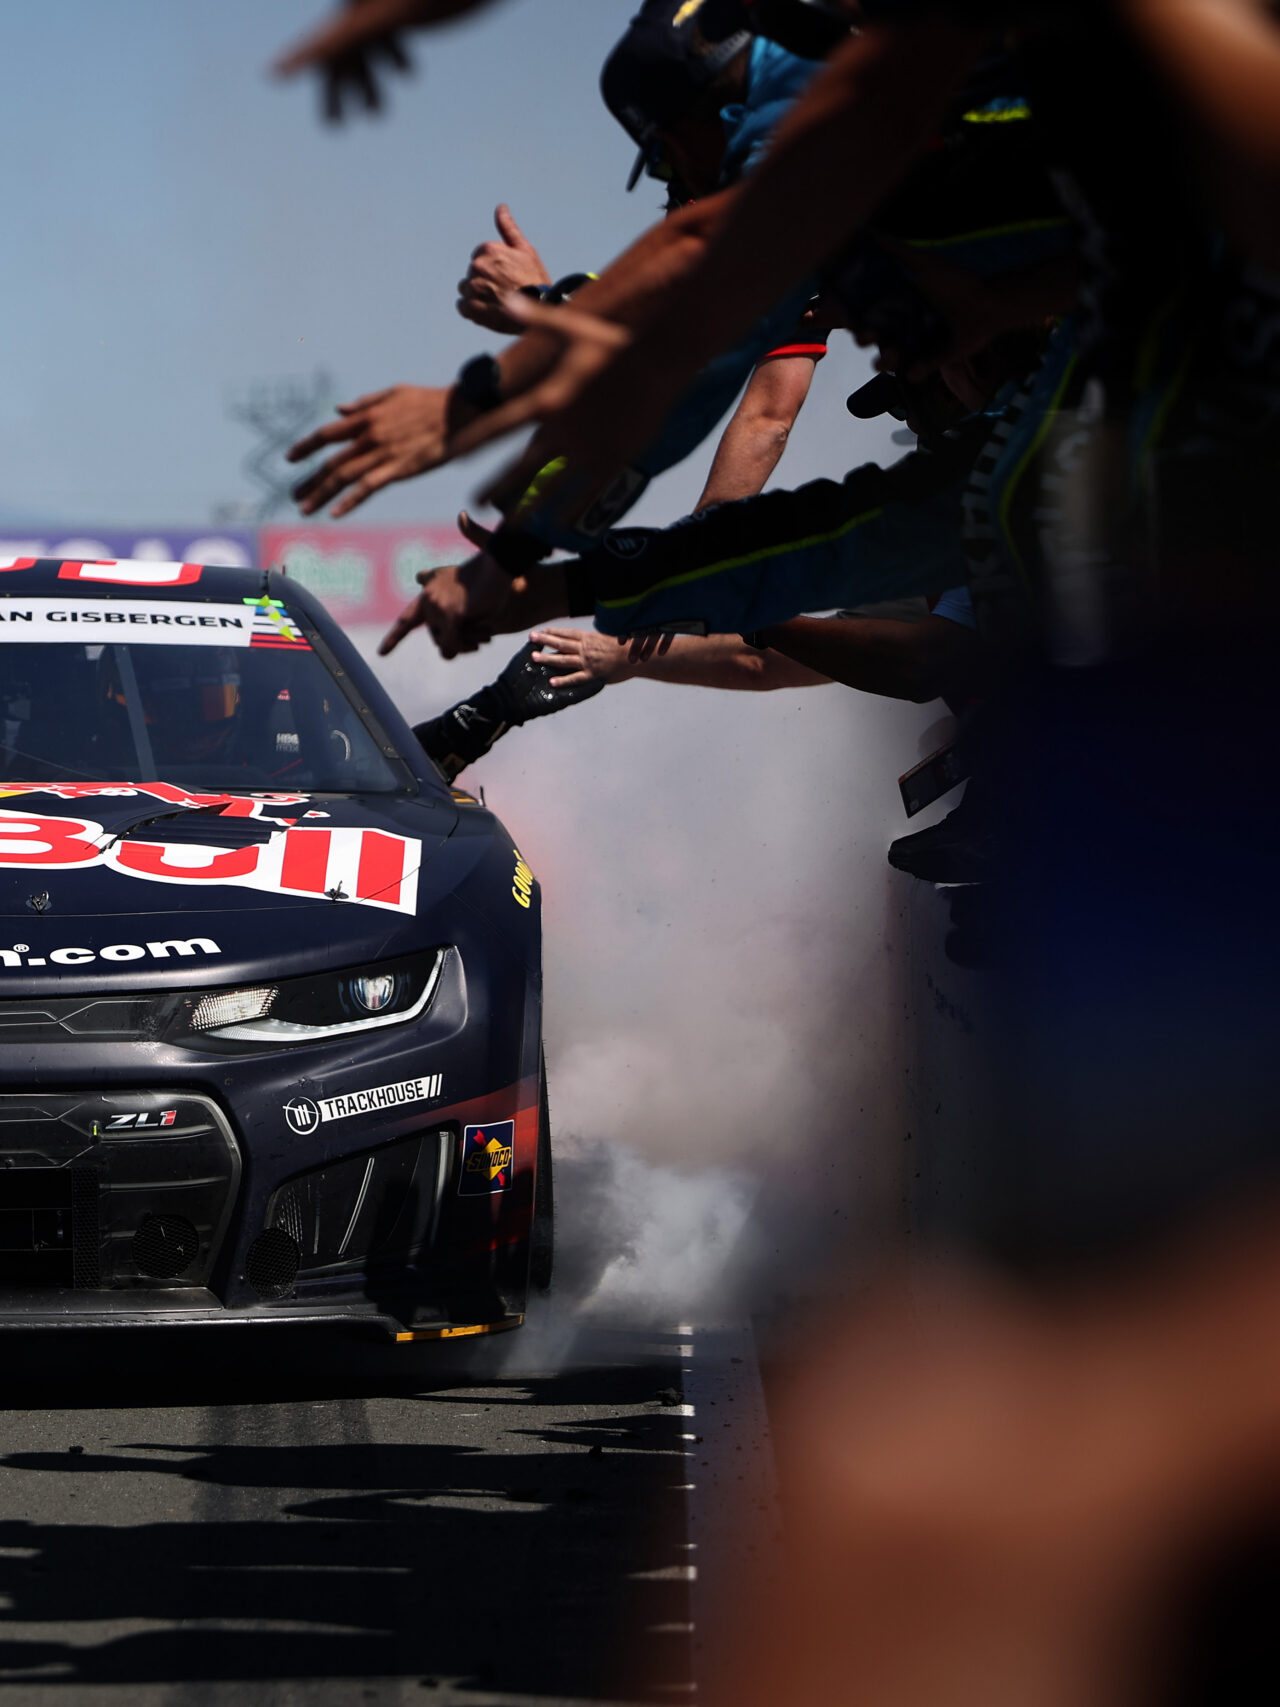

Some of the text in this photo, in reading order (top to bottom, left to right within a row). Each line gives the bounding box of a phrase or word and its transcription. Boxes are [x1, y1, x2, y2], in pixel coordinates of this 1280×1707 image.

[45, 610, 244, 629] GISBERGEN
[324, 1080, 425, 1119] TRACKHOUSE
[105, 1109, 177, 1130] ZL1
[468, 1148, 512, 1172] SUNOCO
